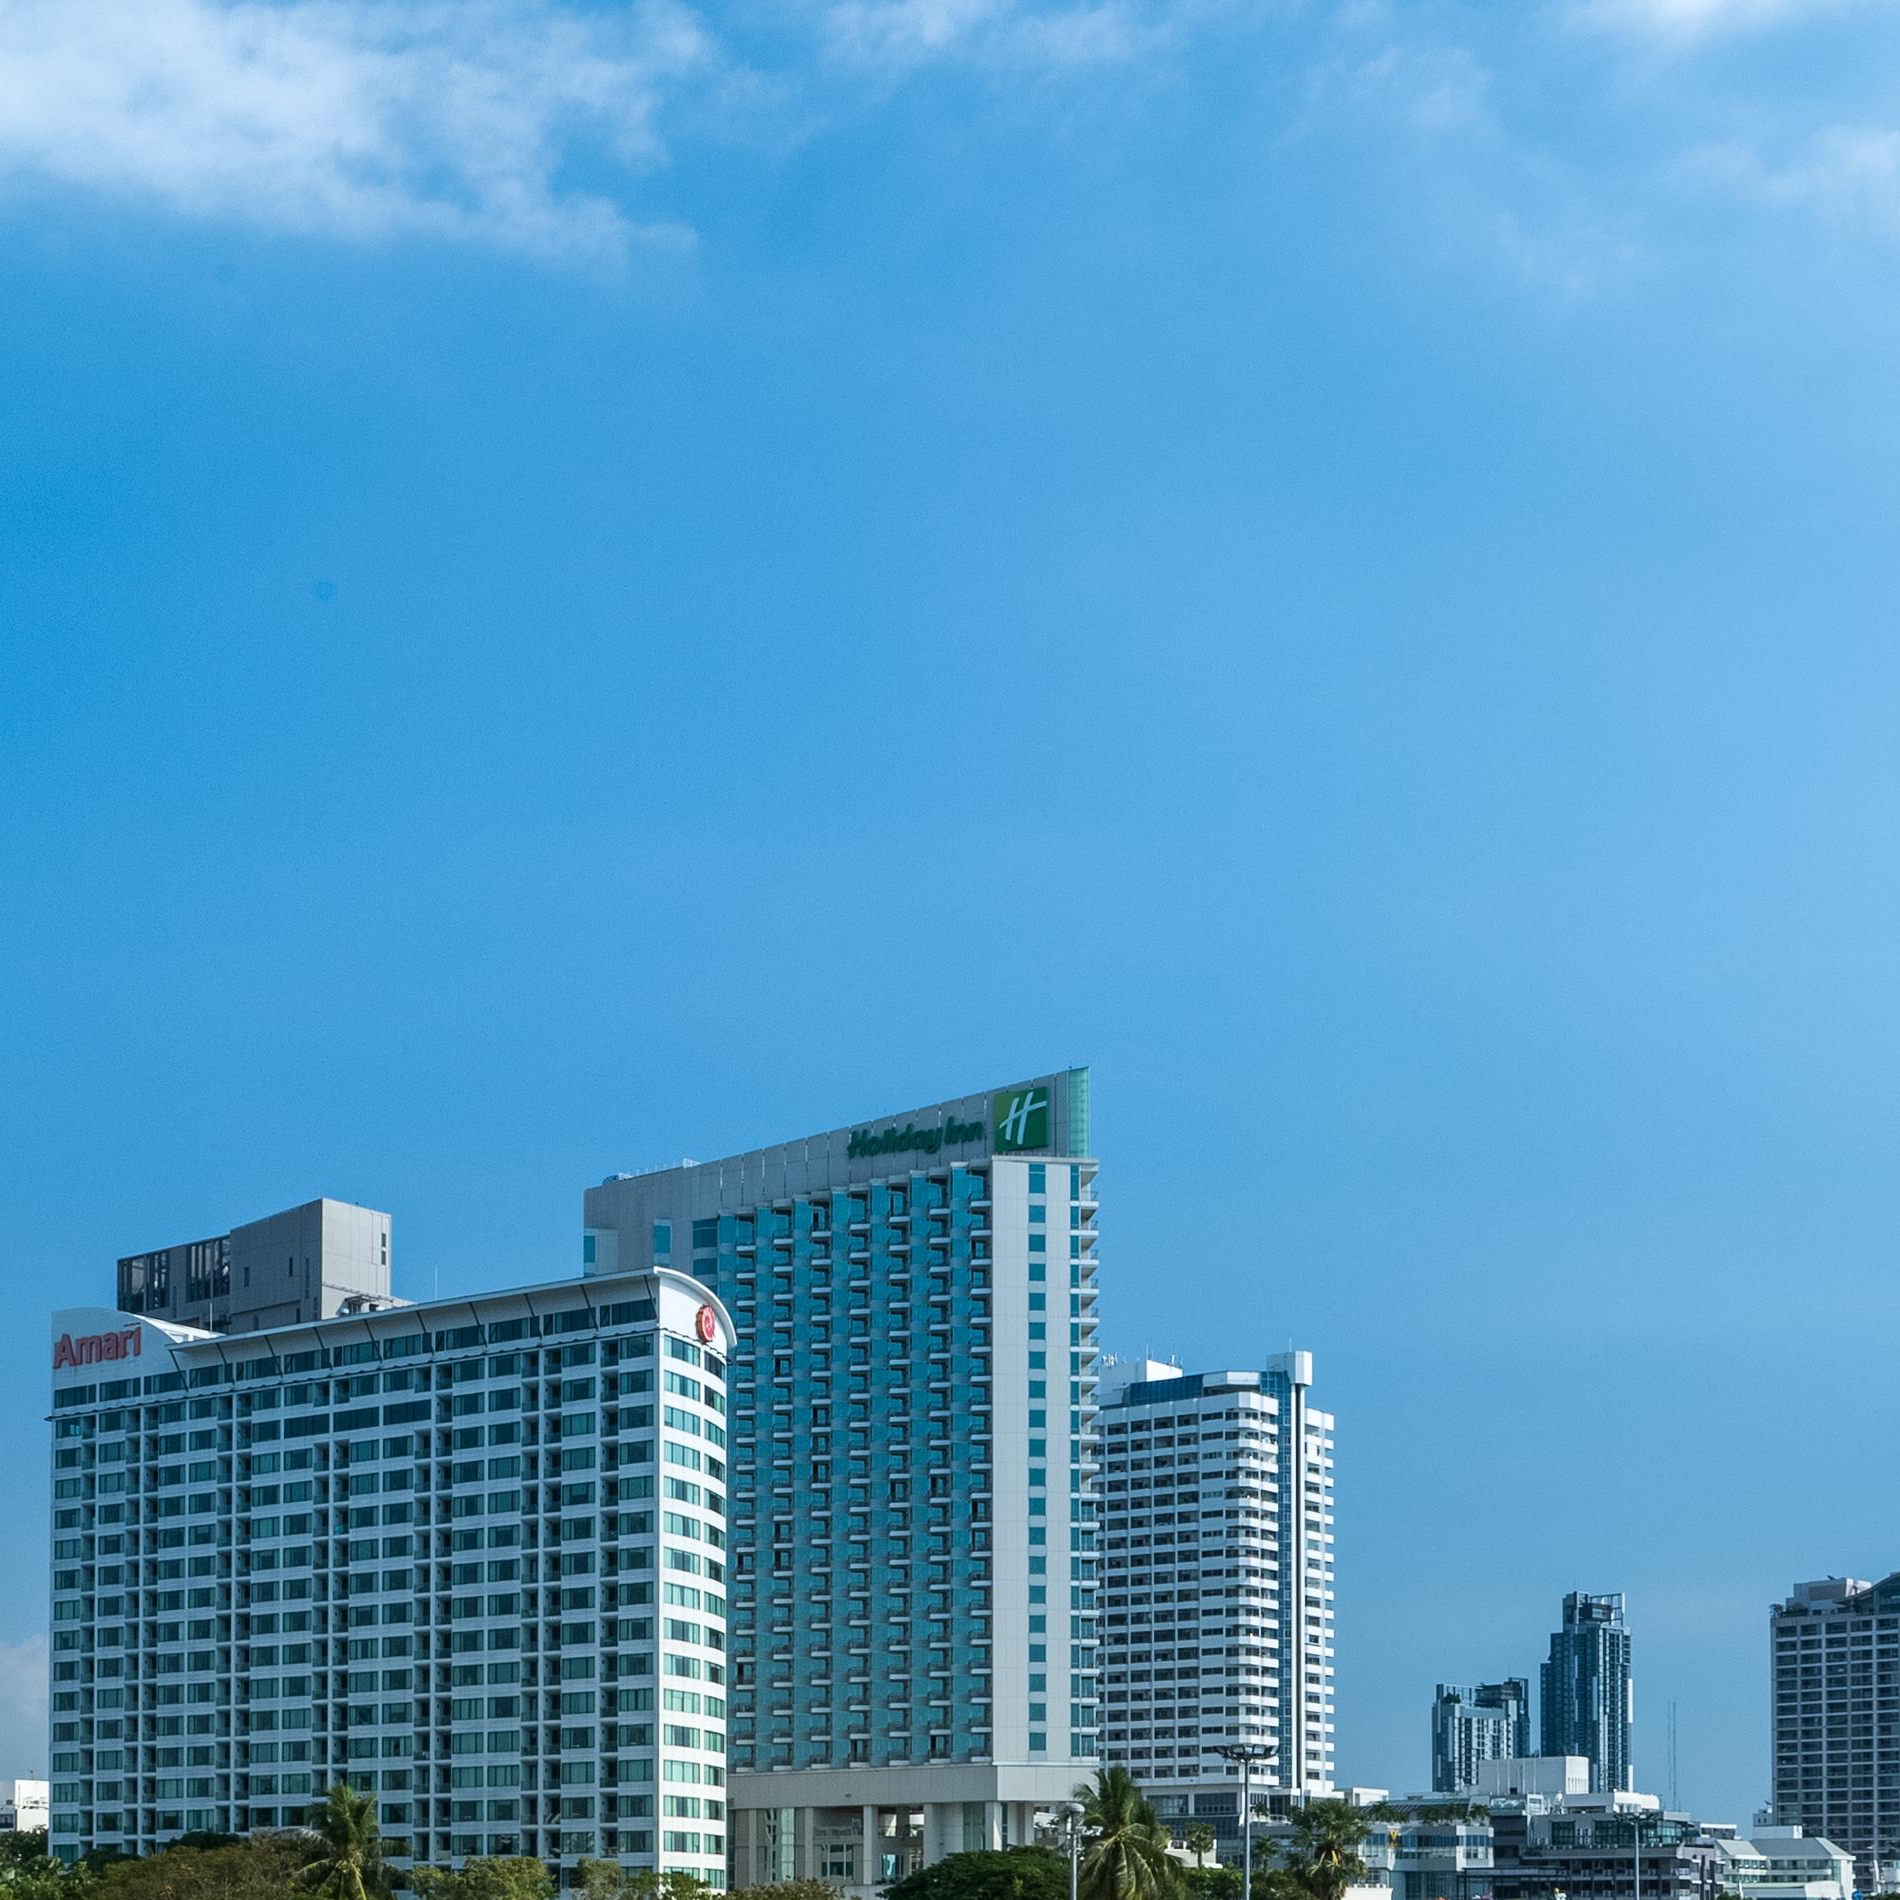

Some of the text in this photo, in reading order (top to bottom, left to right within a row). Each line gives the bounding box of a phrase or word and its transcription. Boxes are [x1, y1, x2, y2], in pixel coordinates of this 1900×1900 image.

[848, 1116, 985, 1159] Holiday Inn
[52, 1327, 141, 1369] Amari
